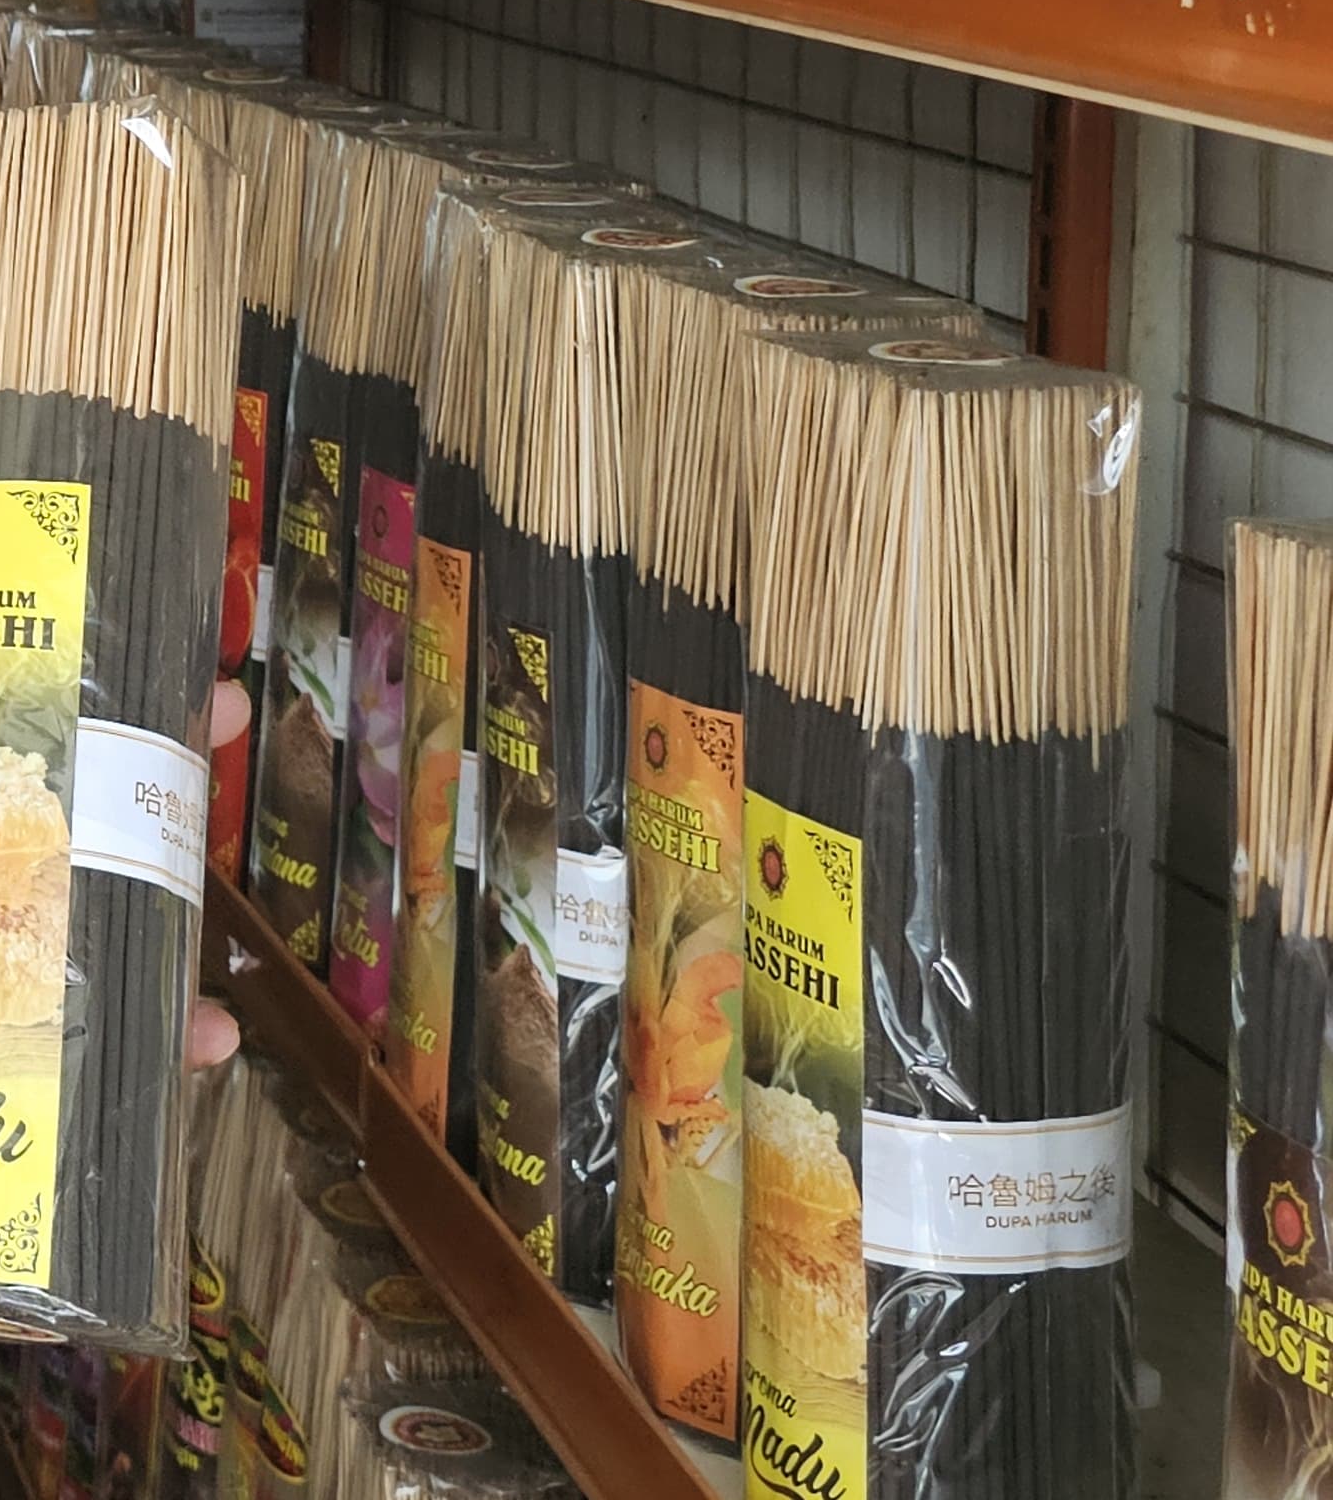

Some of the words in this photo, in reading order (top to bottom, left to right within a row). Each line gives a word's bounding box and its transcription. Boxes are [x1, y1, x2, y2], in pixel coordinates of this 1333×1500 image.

[647, 789, 704, 833] HARUM
[578, 929, 620, 949] DUPA
[765, 913, 825, 962] HARUM
[985, 1215, 1032, 1230] DUPA
[1035, 1208, 1093, 1227] HARUM
[1238, 1293, 1333, 1399] ASSE
